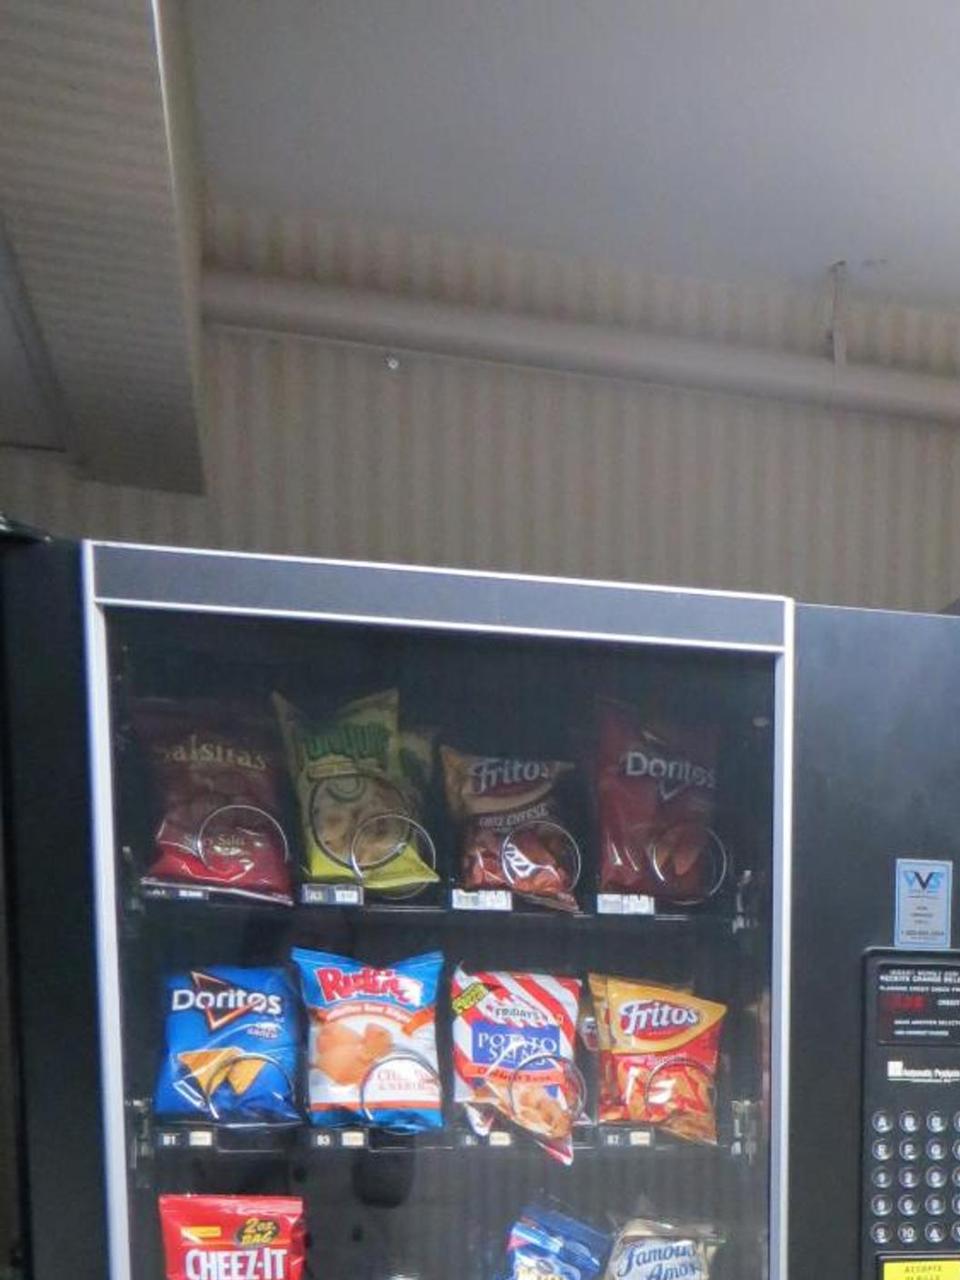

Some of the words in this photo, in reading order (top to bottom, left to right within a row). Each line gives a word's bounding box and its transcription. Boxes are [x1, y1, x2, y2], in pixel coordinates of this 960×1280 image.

[473, 758, 549, 796] Fritos
[626, 751, 715, 789] Doritos
[172, 989, 281, 1015] Doritos
[618, 1000, 698, 1033] Fritos
[477, 1032, 558, 1054] POTTO
[244, 1217, 259, 1233] 2
[617, 1243, 697, 1278] Famous
